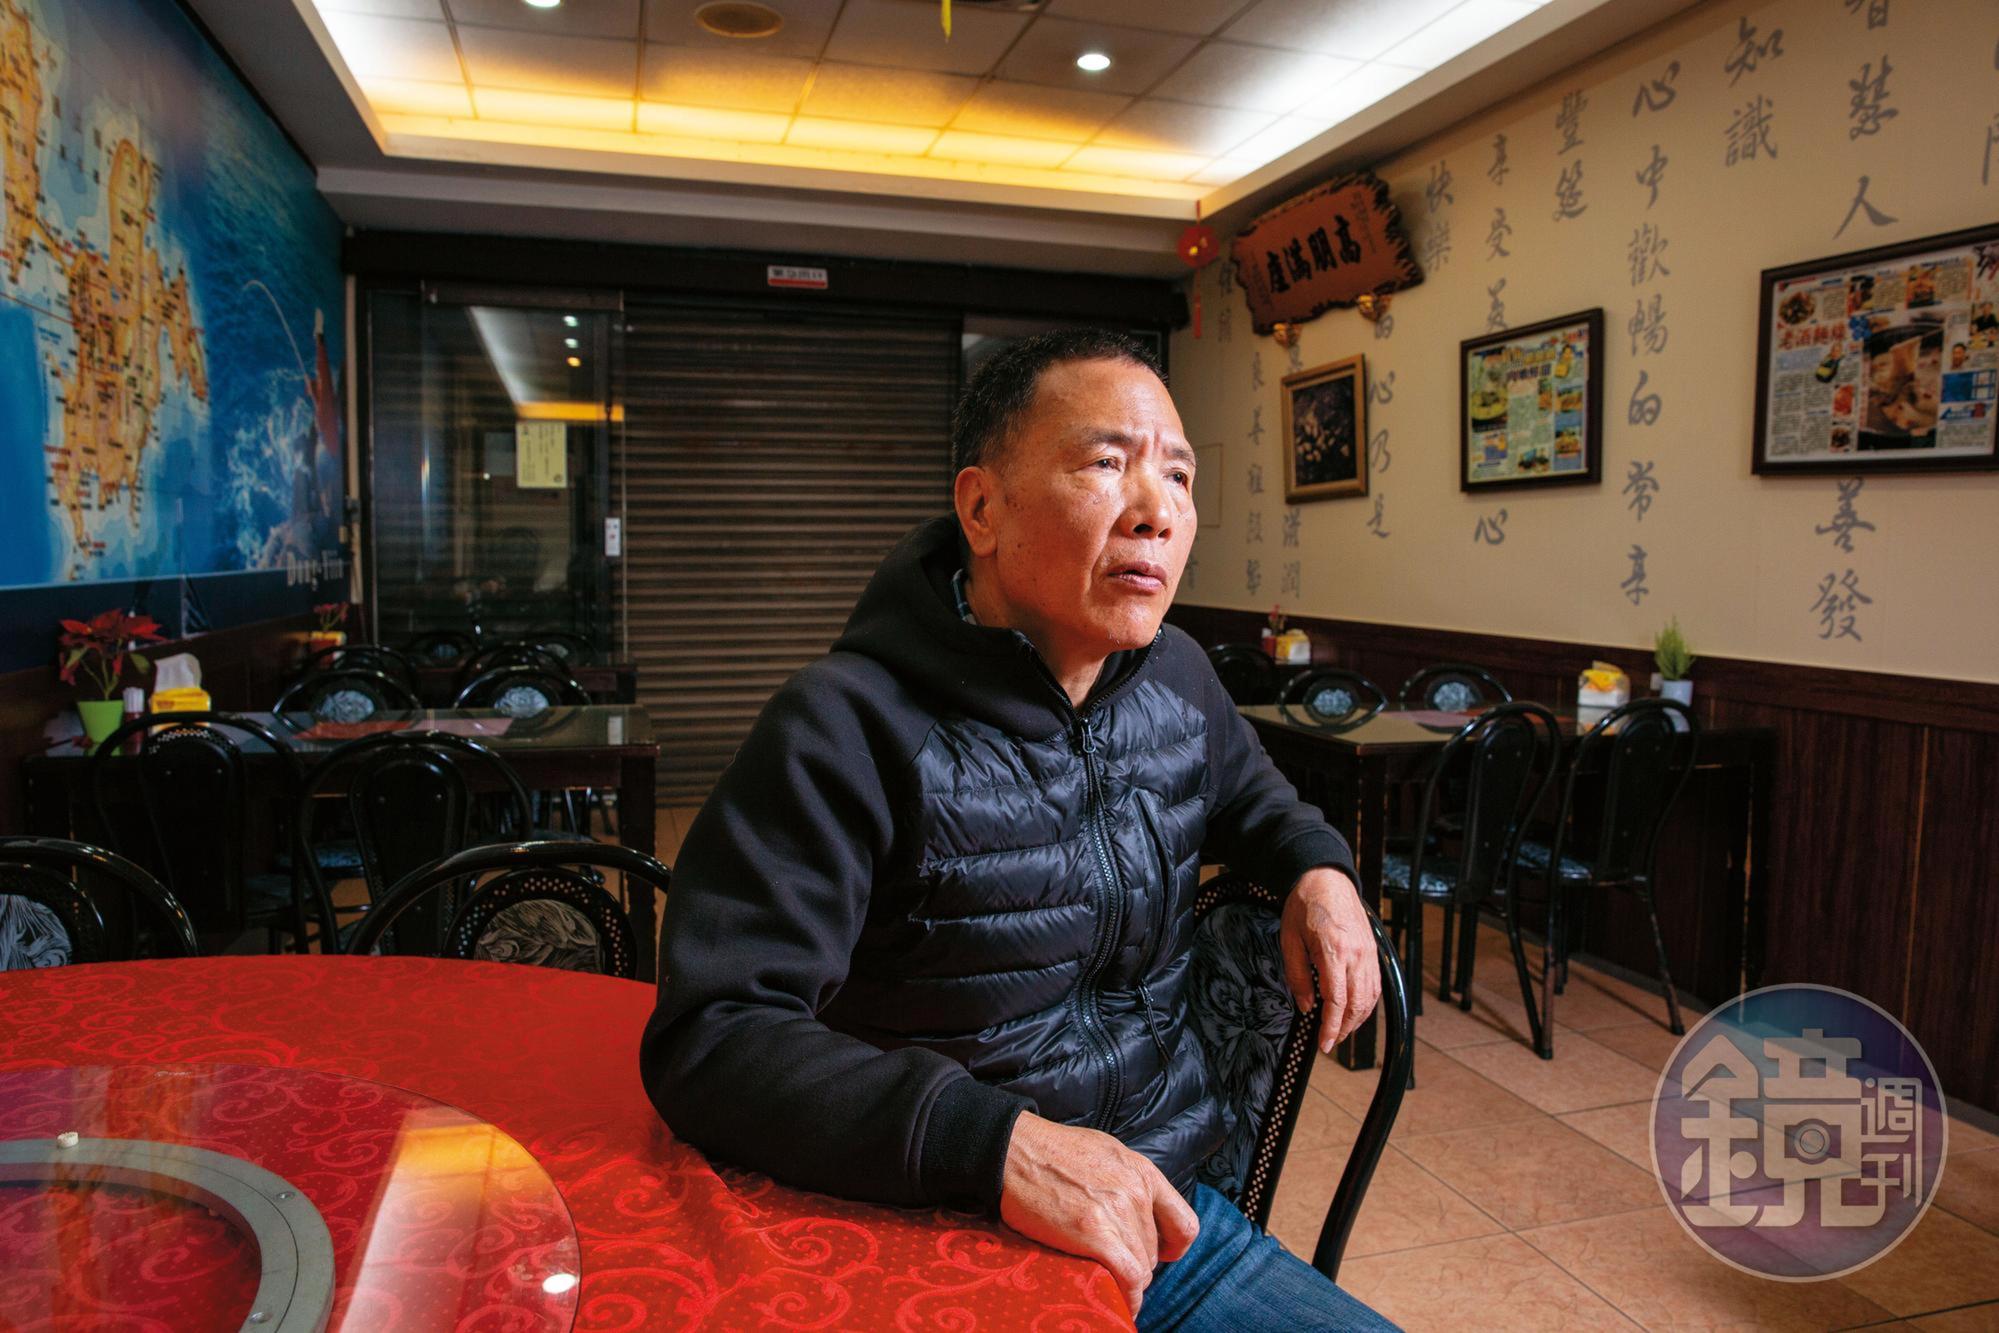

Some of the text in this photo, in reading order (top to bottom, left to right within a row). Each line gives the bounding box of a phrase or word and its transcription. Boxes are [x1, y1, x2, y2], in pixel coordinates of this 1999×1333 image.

[1725, 16, 1784, 167] 知識
[1425, 159, 1454, 273] 快樂
[1620, 60, 1680, 606] 心中歡暢的常享
[1810, 477, 1876, 642] 善發
